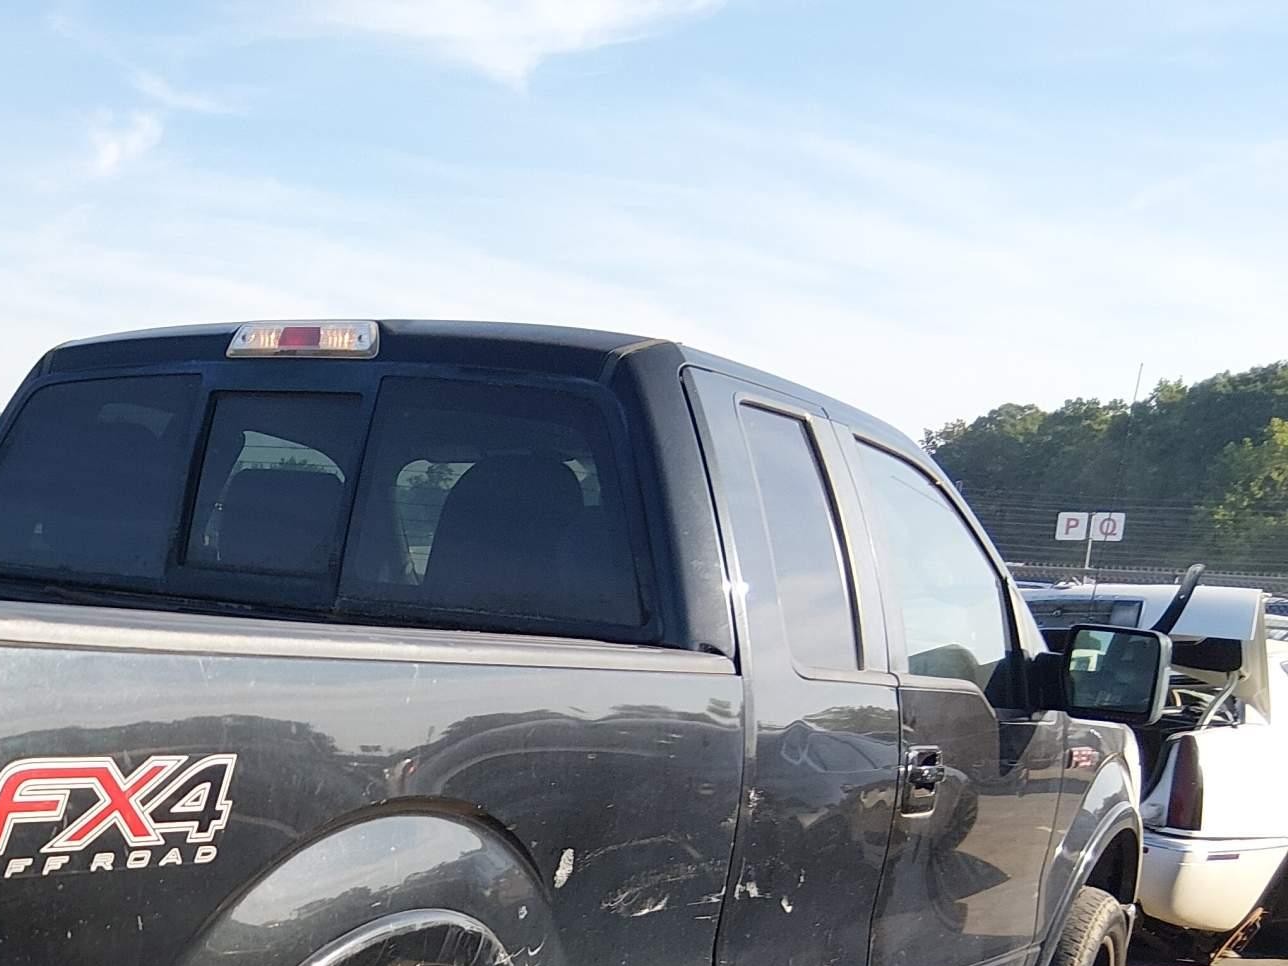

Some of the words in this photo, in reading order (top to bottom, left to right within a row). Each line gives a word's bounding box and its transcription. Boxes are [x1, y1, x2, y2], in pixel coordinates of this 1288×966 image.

[1064, 517, 1079, 535] P
[1099, 517, 1117, 536] Q
[90, 845, 218, 872] ROAD
